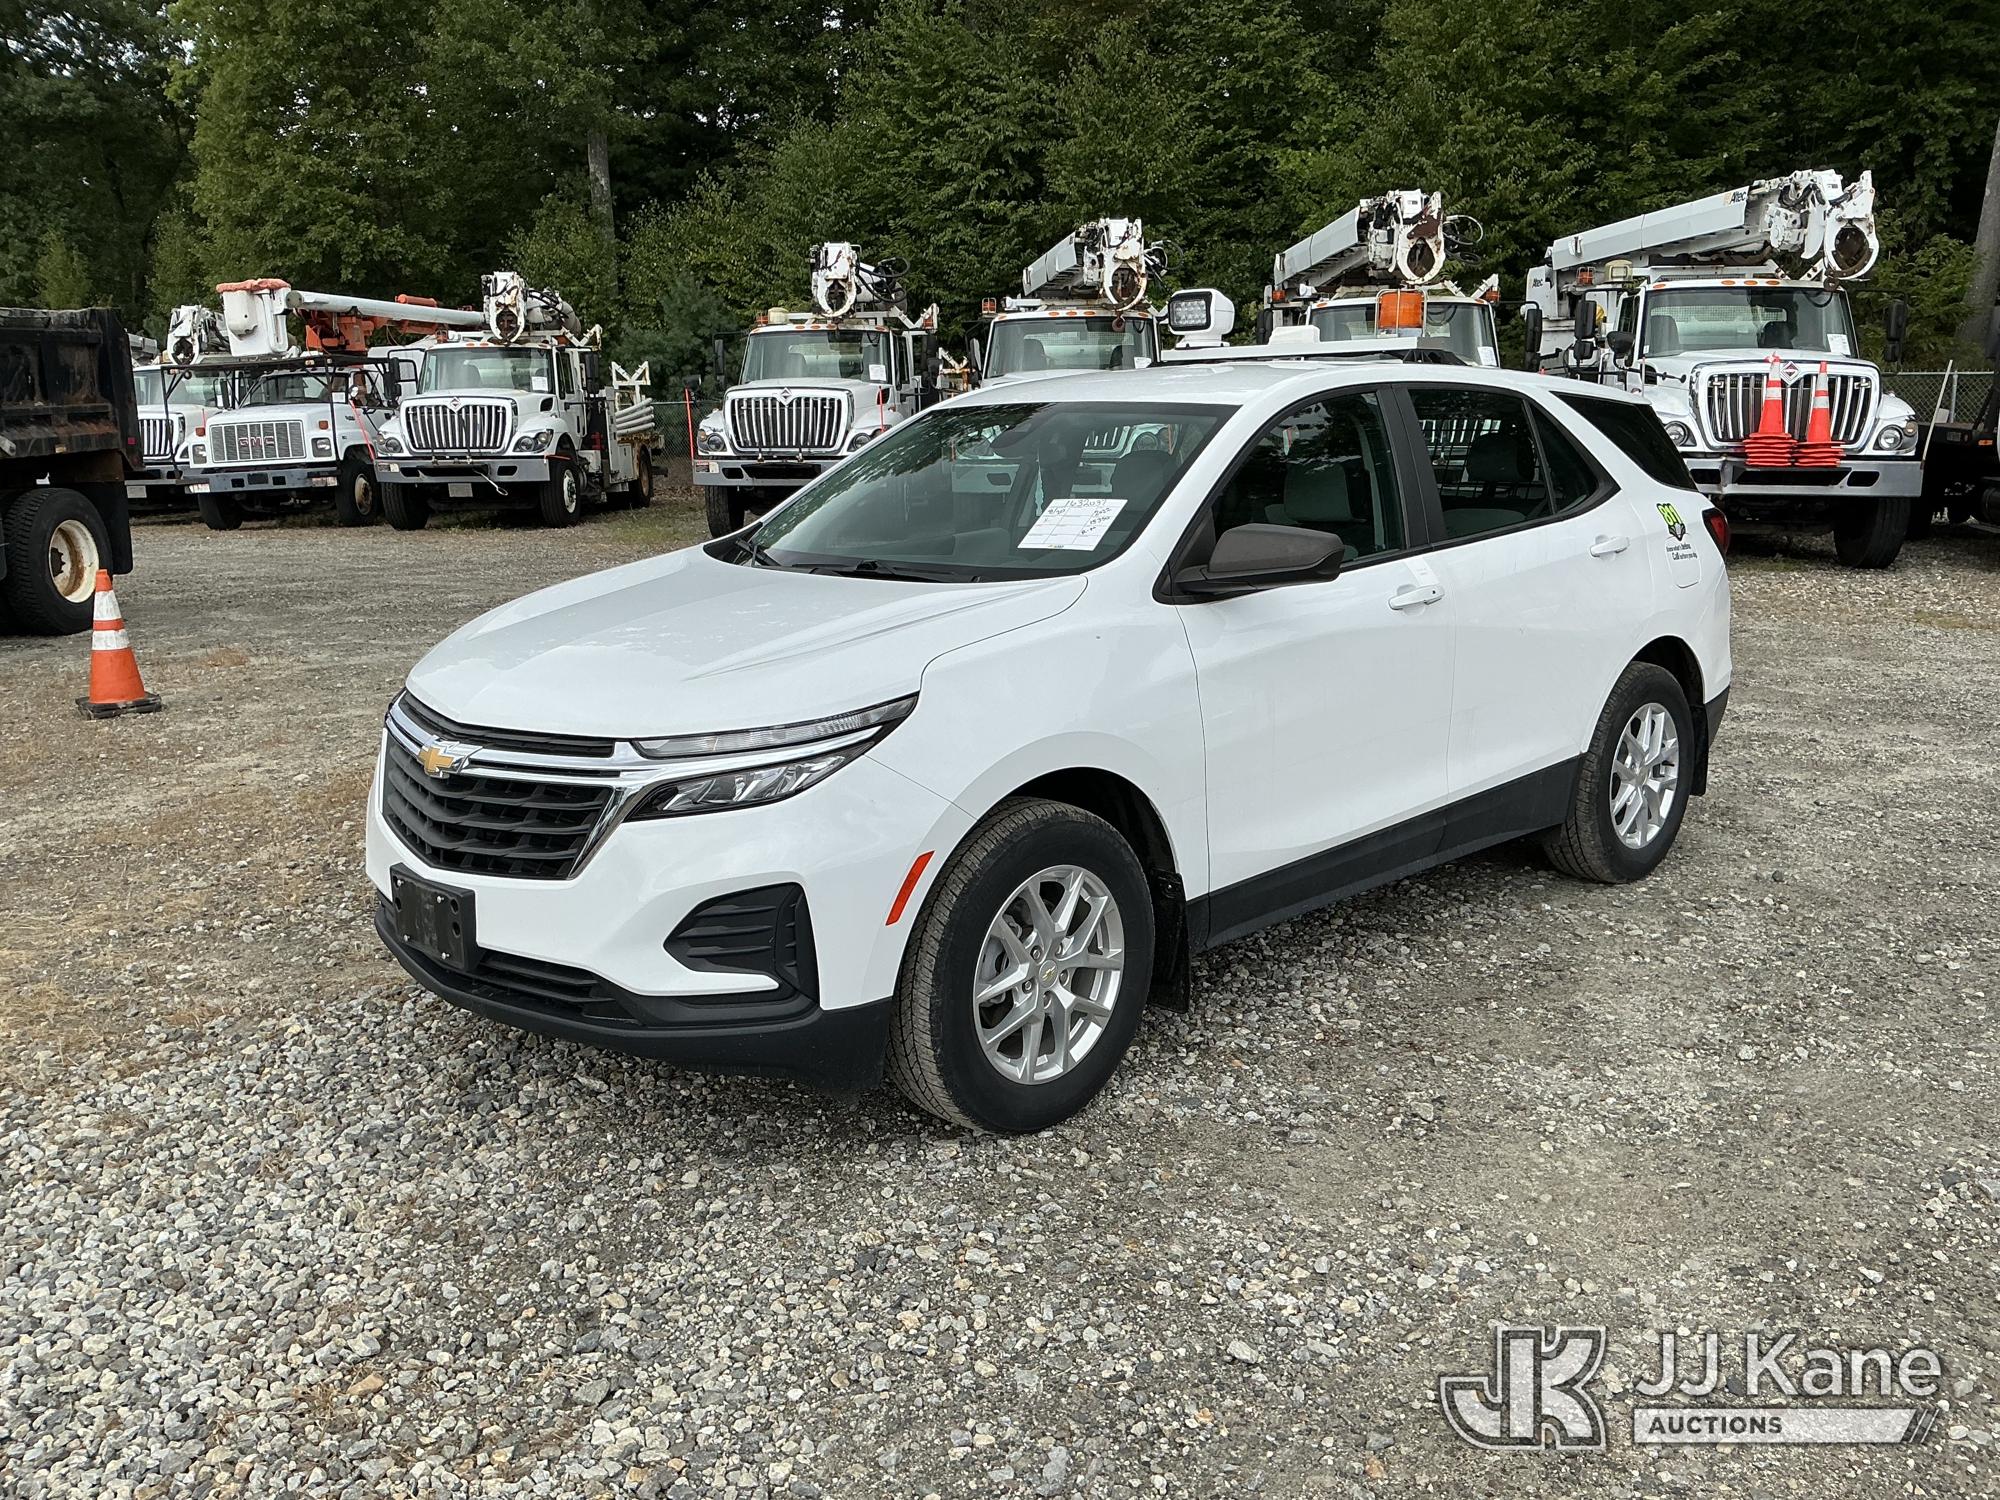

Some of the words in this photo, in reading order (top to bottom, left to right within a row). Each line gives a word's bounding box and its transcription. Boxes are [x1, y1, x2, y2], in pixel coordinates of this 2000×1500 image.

[1730, 190, 1746, 204] Altec
[238, 435, 275, 447] GMC
[1656, 503, 1684, 526] 811
